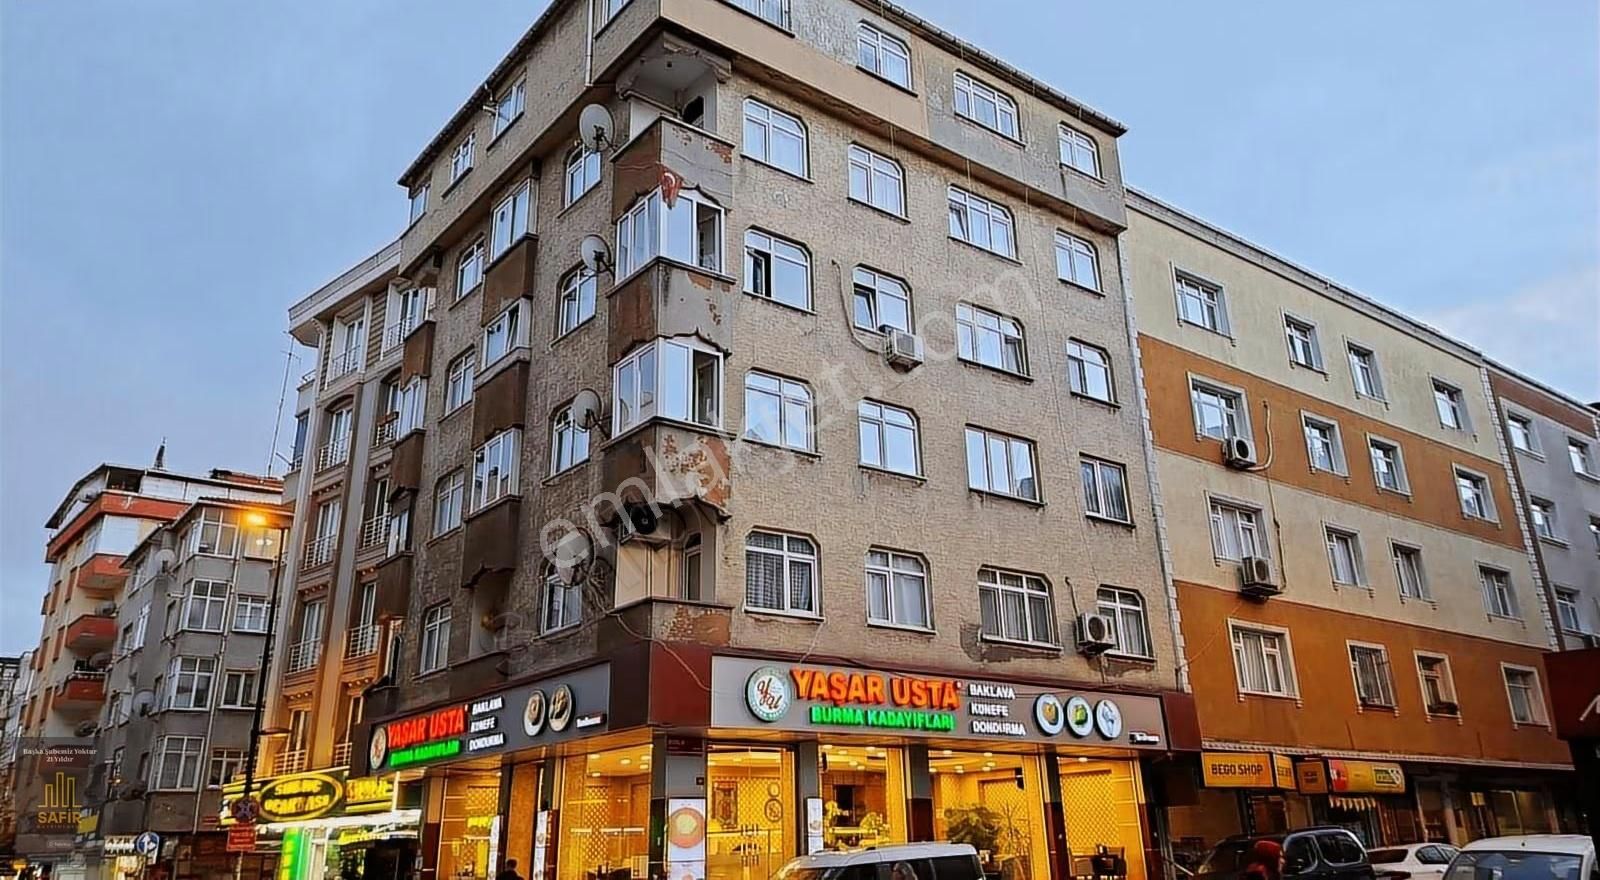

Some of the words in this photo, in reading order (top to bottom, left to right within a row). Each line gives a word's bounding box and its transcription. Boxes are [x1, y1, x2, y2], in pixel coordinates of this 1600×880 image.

[791, 668, 884, 705] YAŞAR
[892, 677, 960, 709] USTA
[969, 684, 1016, 701] BAKLAVA
[387, 717, 427, 749] YAŞAR
[430, 707, 465, 740] USTA
[810, 706, 865, 726] BURMA
[866, 711, 955, 731] KADAYIFLARI
[972, 720, 1027, 738] DONDURMA
[1211, 763, 1237, 776] BEGO
[1238, 763, 1264, 776] SHOP
